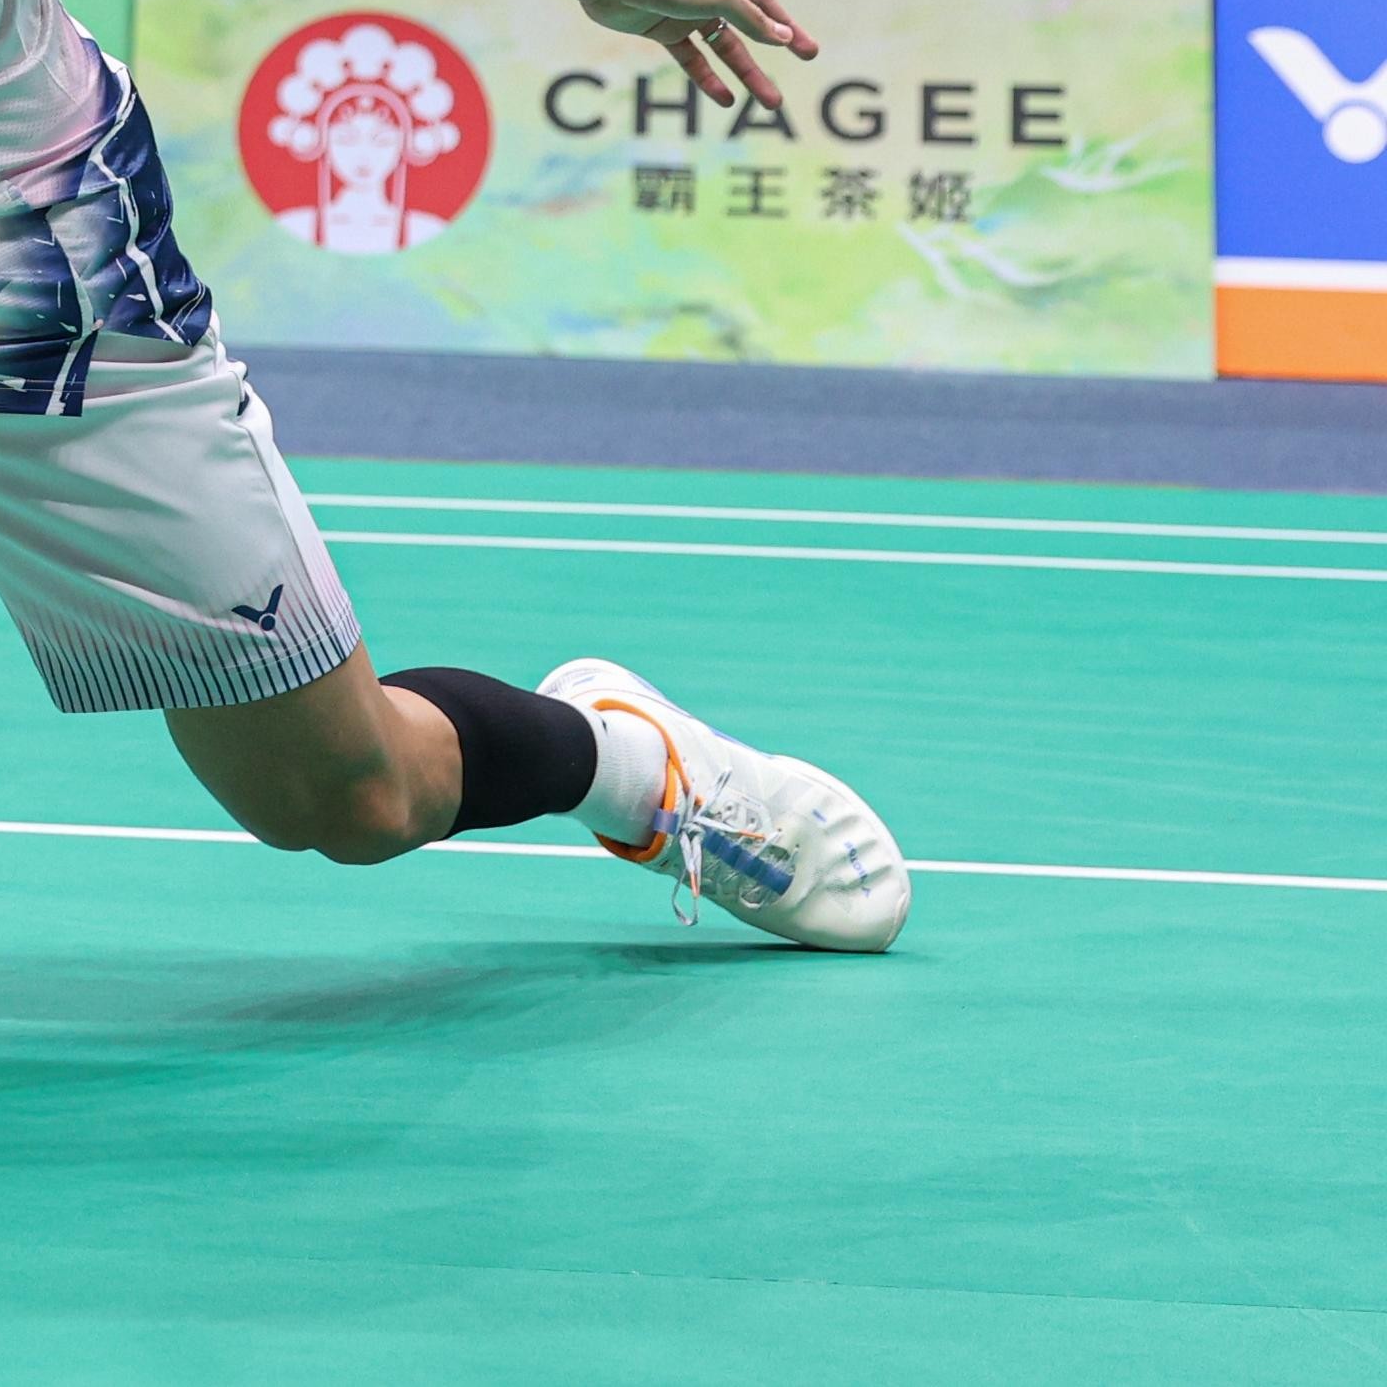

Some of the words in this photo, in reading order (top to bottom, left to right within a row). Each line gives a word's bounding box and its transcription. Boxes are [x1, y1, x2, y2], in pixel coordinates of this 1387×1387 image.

[543, 71, 1068, 147] CHAGEE
[634, 163, 973, 224] 霸王茶姬
